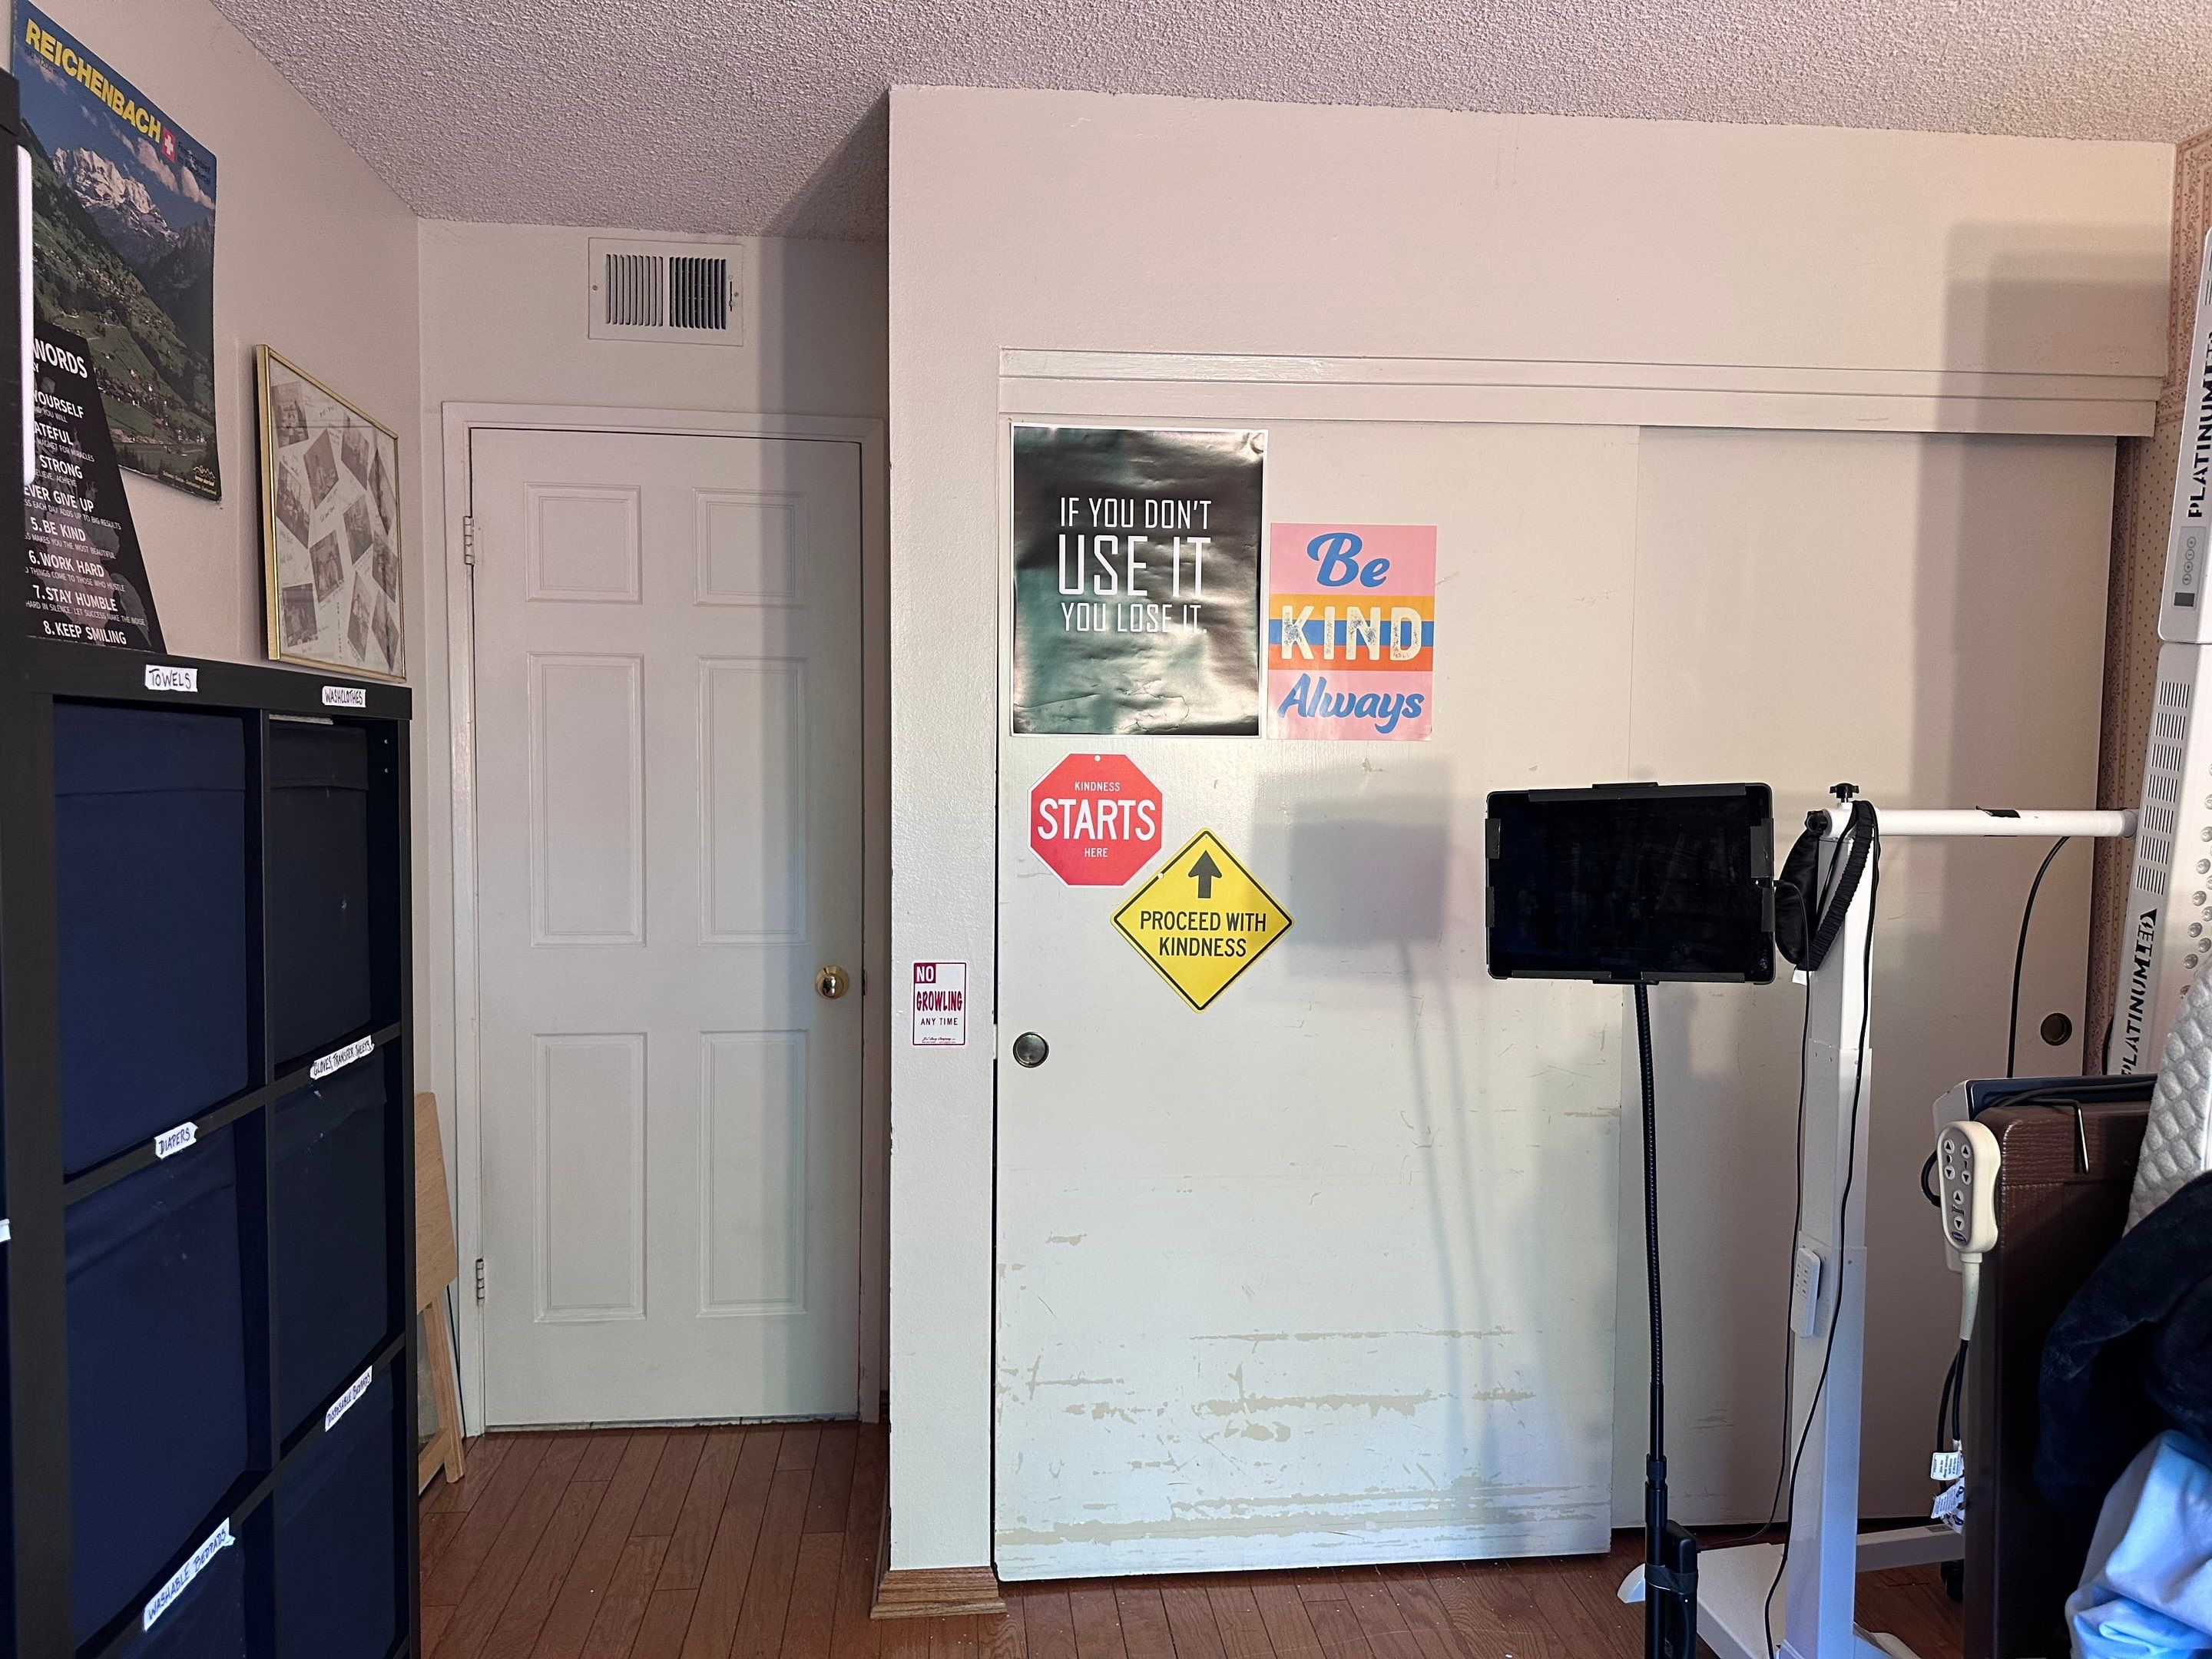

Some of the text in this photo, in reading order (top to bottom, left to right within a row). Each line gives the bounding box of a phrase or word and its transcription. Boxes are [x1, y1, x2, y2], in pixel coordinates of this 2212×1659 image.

[25, 18, 161, 143] REICHENBACH
[34, 338, 88, 379] WORDS
[34, 421, 74, 446] ATEFUL
[59, 445, 71, 455] FOR
[39, 455, 83, 479] STRONG
[24, 484, 51, 502] EVER
[53, 490, 78, 508] GIVE
[79, 497, 94, 513] UP
[33, 500, 47, 512] EACH
[48, 504, 58, 513] DAY
[60, 508, 74, 518] ADDS
[82, 514, 91, 522] TO
[91, 516, 101, 525] BIG
[101, 518, 122, 530] RESULTS
[1060, 497, 1212, 530] IF YOU DON'T
[60, 523, 85, 541] KIND
[32, 533, 50, 545] MAKES
[51, 537, 62, 547] YOU
[63, 541, 75, 550] THE
[75, 543, 89, 553] MOST
[90, 546, 116, 559] BEAUTIFUL
[76, 559, 104, 578] HARD
[1058, 534, 1211, 598] USE IT
[1306, 532, 1389, 588] Be
[30, 567, 51, 578] THINGS
[51, 571, 67, 581] COME
[68, 574, 75, 582] TO
[76, 575, 94, 586] THOSE
[94, 579, 106, 588] WHO
[107, 582, 125, 592] HUSTLE
[75, 591, 118, 612] HUMBLE
[84, 609, 107, 620] SUCCESS
[107, 613, 121, 623] MAKE
[131, 617, 146, 626] NOISE
[1061, 602, 1207, 634] YOU LOSE IT.
[85, 626, 127, 645] SMILING
[1281, 605, 1422, 661] KIND
[149, 668, 191, 690] TOWELS
[1277, 673, 1425, 733] Always
[1075, 782, 1121, 792] KINDNESS
[1038, 798, 1156, 841] STARTS
[1084, 847, 1108, 857] HERE
[1140, 910, 1267, 932] PROCEED WITH
[1159, 936, 1247, 957] KINDNESS
[916, 965, 935, 982] NO
[916, 991, 962, 1012] GROWLING
[158, 1128, 190, 1155] DIAPERS
[148, 1562, 190, 1621] WASHABLE
